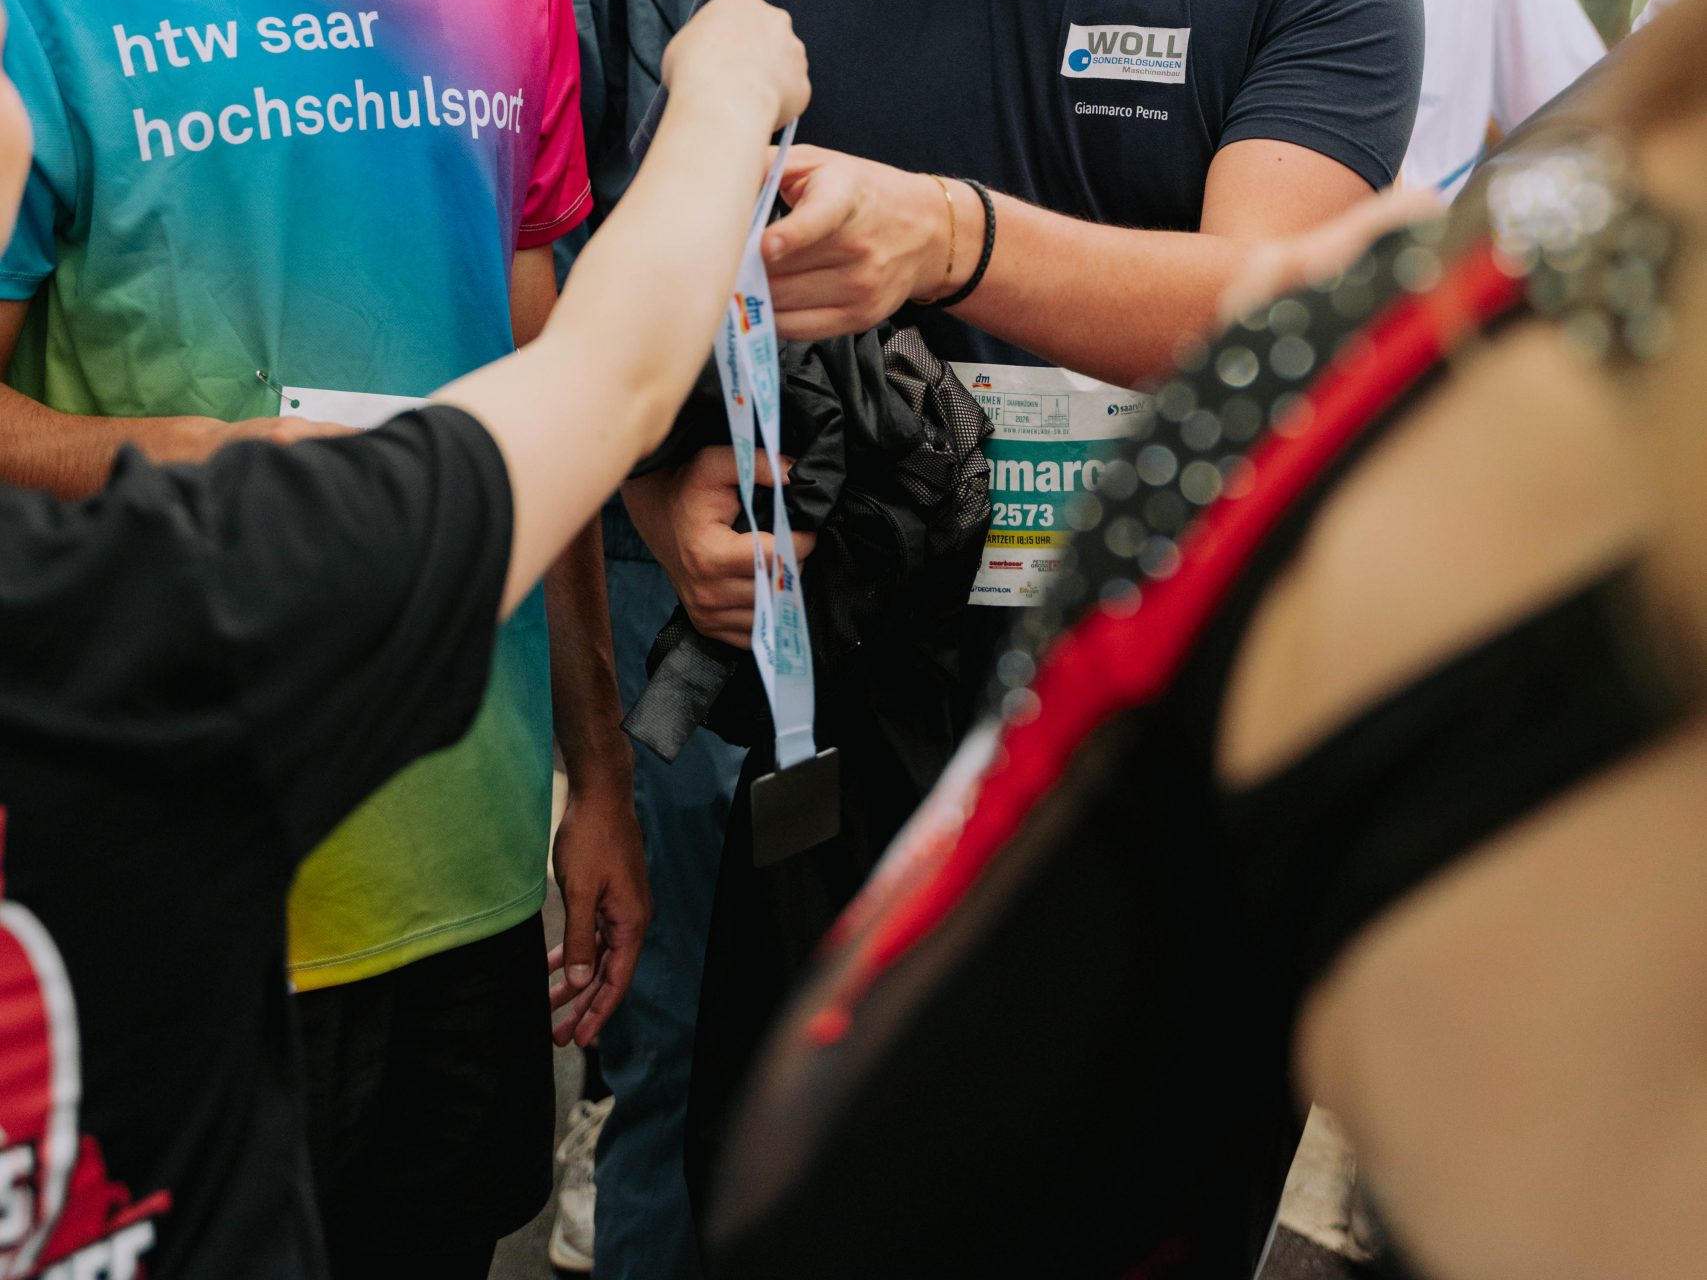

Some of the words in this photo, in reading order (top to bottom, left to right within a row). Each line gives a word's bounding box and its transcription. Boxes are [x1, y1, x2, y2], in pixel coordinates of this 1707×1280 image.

[112, 18, 238, 78] htw
[256, 10, 379, 54] saar
[1087, 31, 1183, 59] WOLL
[1122, 66, 1181, 77] Maschinenbau
[132, 75, 524, 162] hochschulsport
[1074, 101, 1133, 117] Gianmarco
[1135, 105, 1169, 120] Perna
[745, 295, 764, 326] dm
[975, 373, 990, 383] dm
[975, 395, 1001, 405] FIRMEN
[992, 502, 1055, 527] 2573
[985, 535, 1015, 545] ARTZEIT
[1016, 535, 1034, 545] 18:15
[1035, 536, 1051, 545] UHR
